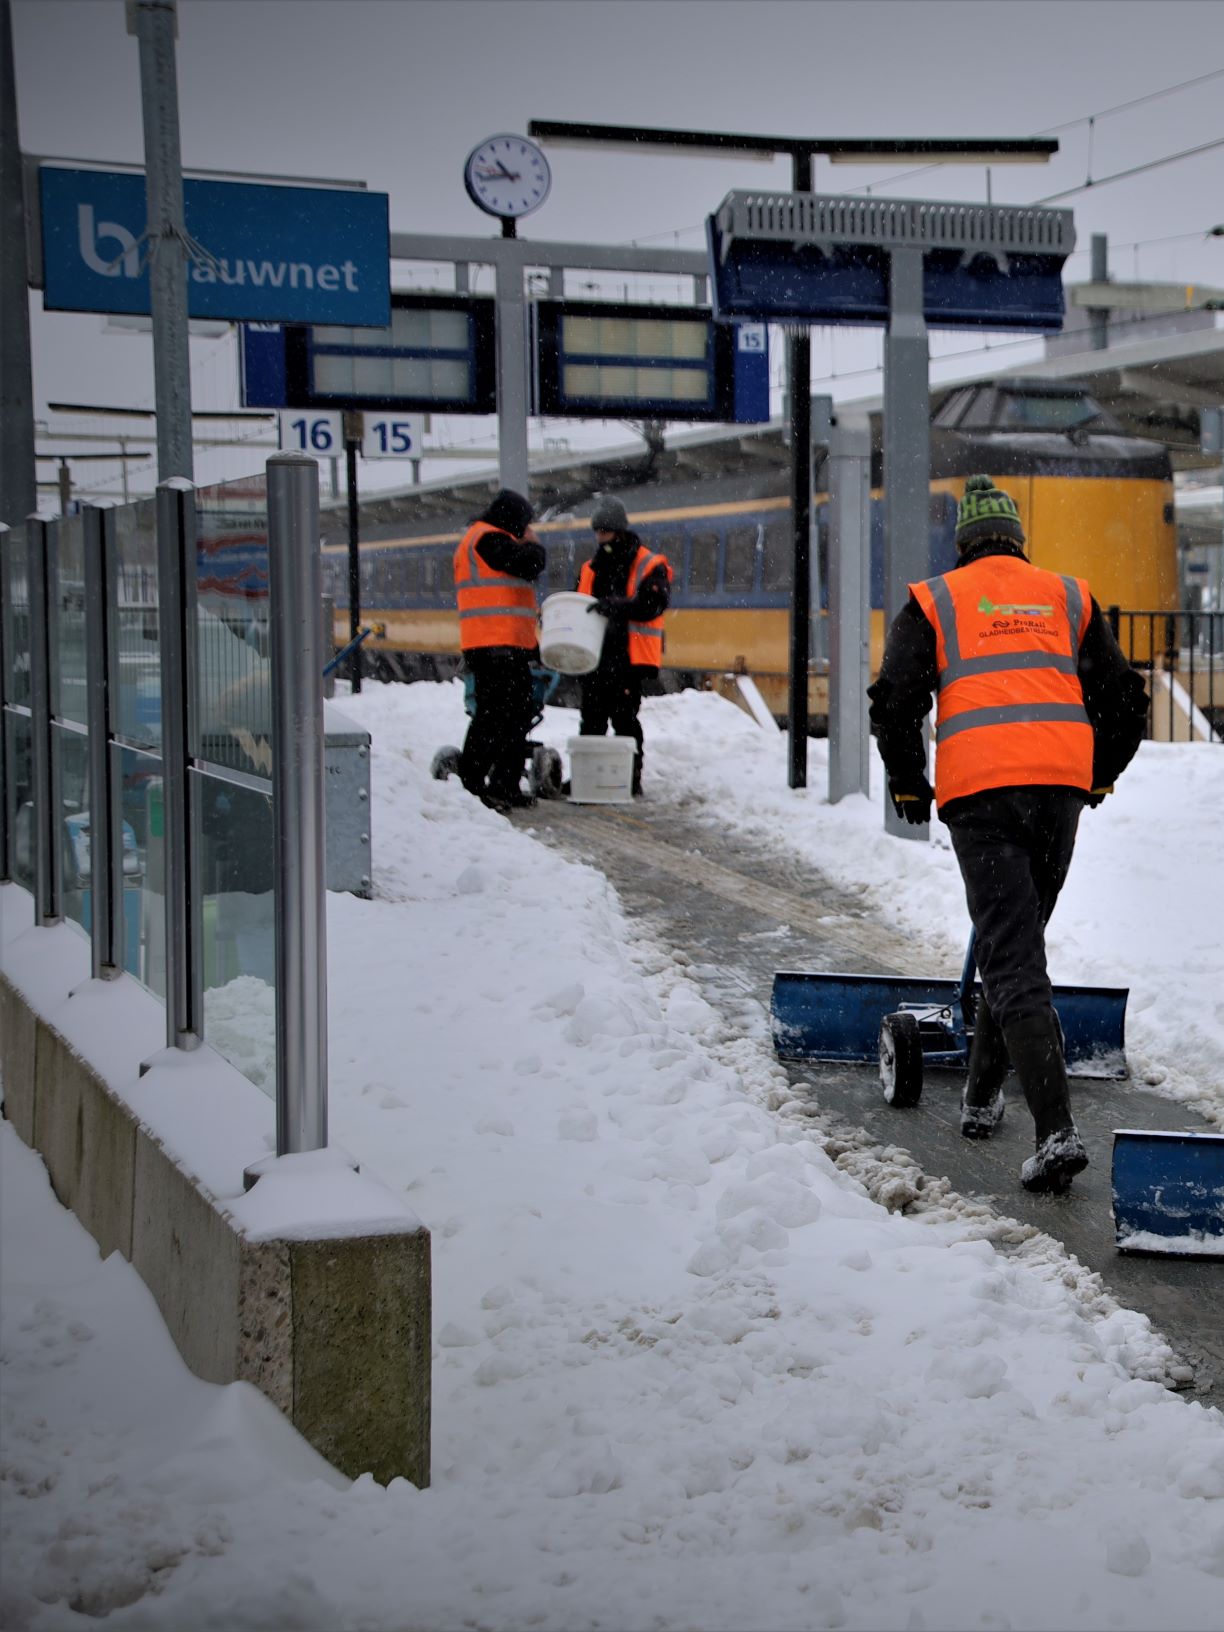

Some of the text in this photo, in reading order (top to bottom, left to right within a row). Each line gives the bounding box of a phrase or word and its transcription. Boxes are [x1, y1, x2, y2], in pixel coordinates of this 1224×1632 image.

[186, 255, 359, 292] auwnet
[741, 332, 761, 348] 15
[291, 418, 333, 450] 16
[372, 421, 412, 453] 15
